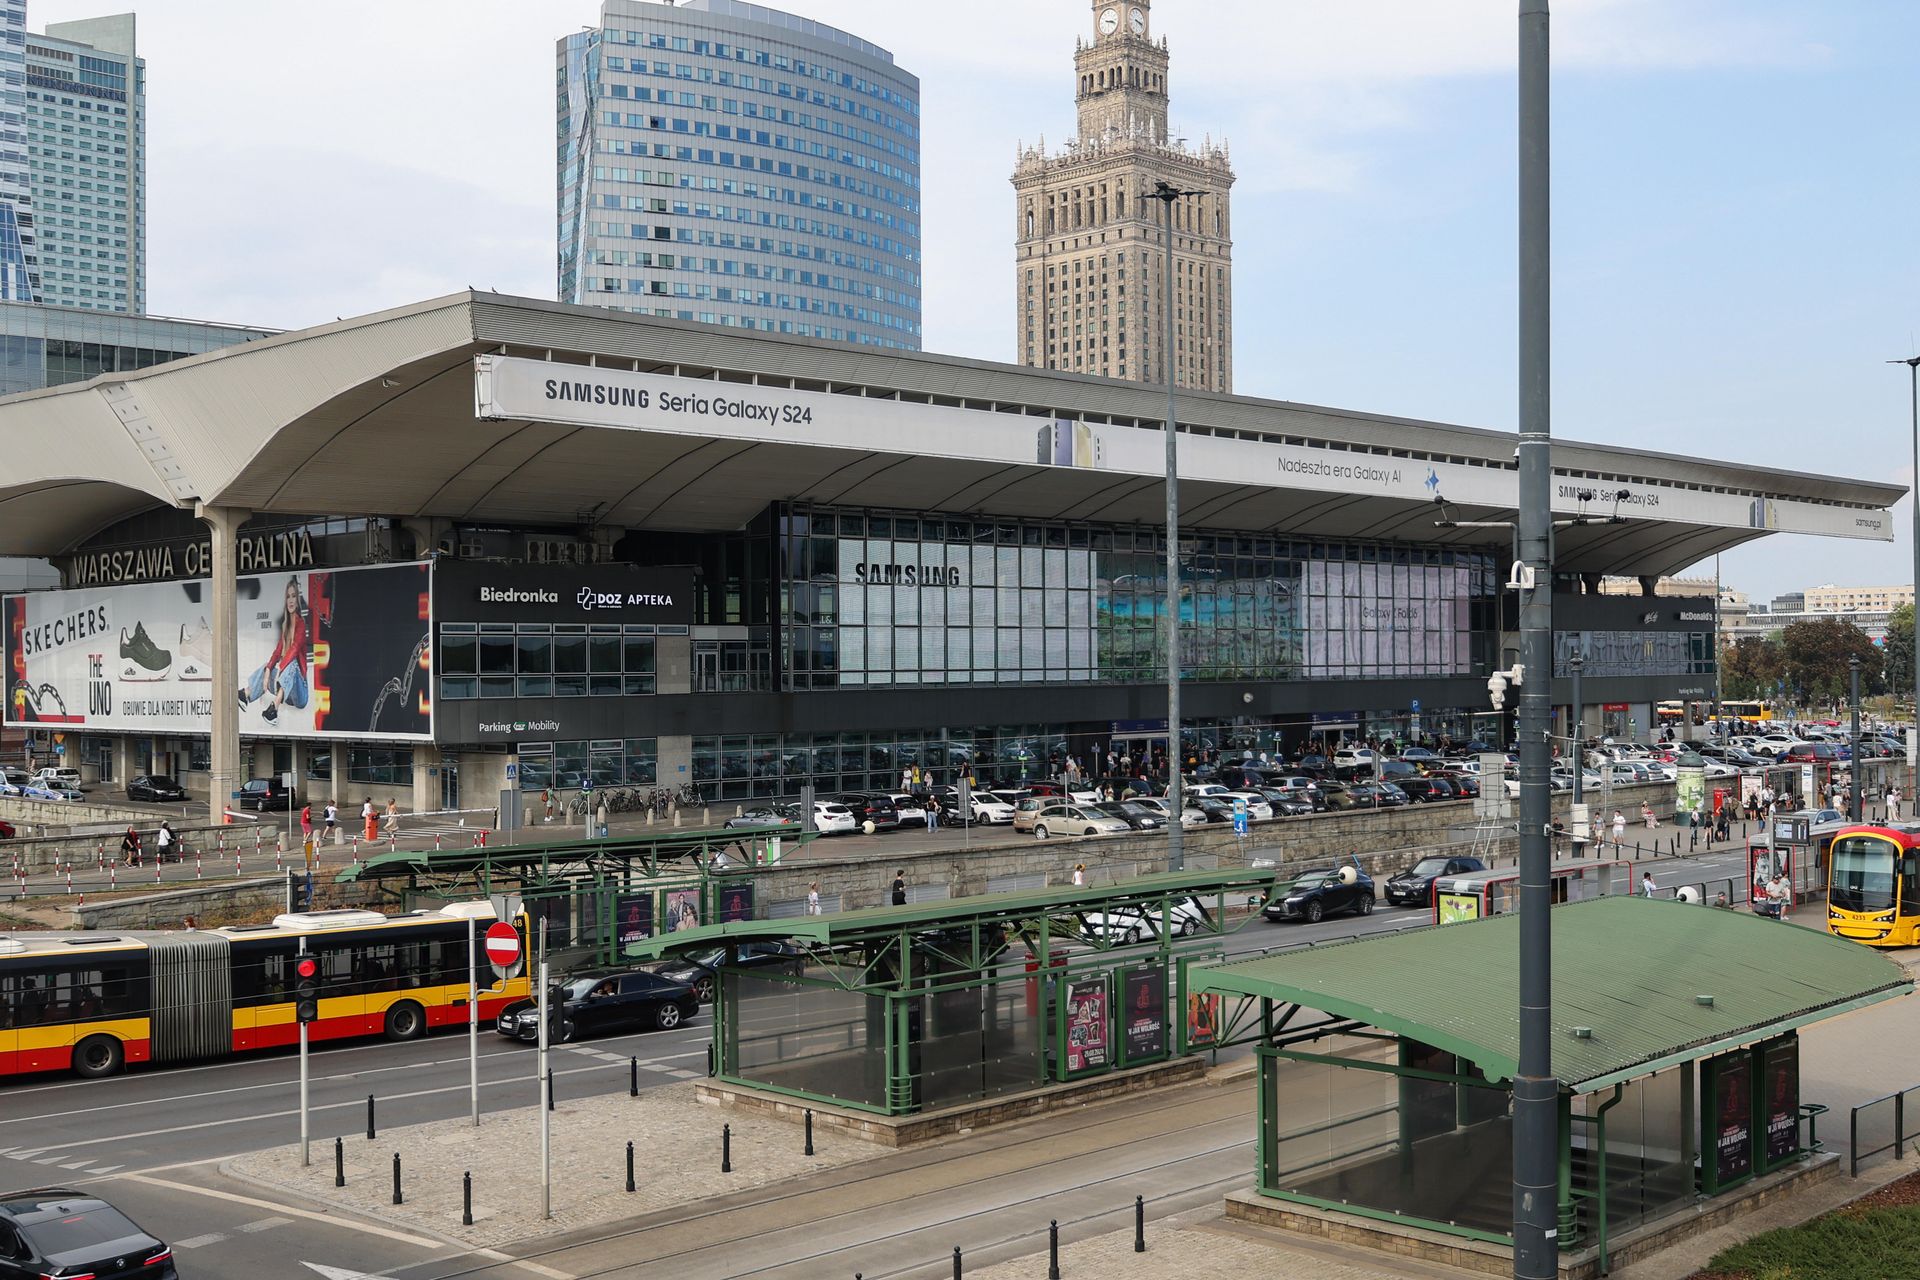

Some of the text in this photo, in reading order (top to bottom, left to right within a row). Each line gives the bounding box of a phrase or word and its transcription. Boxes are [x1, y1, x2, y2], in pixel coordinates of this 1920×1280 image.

[545, 379, 812, 426] SAMSUNG Seria Galaxy S24
[1278, 457, 1401, 486] Nadeszła era Galaxy AI
[1647, 494, 1659, 506] S24
[1855, 518, 1881, 531] samsung.pl
[73, 530, 313, 584] WARSZAWA CERALNA
[855, 562, 960, 587] SAMSUNG
[480, 587, 558, 603] Biedronka
[597, 593, 673, 606] DOZ APTEKA
[1680, 611, 1713, 621] McDonald's
[25, 605, 107, 656] SKECHERS
[88, 654, 103, 679] THE
[89, 681, 111, 716] UNO
[122, 696, 212, 719] OBUWIE DLA KOBIET I MĘŻCZ
[479, 722, 511, 733] Parking
[528, 720, 560, 732] Mobility
